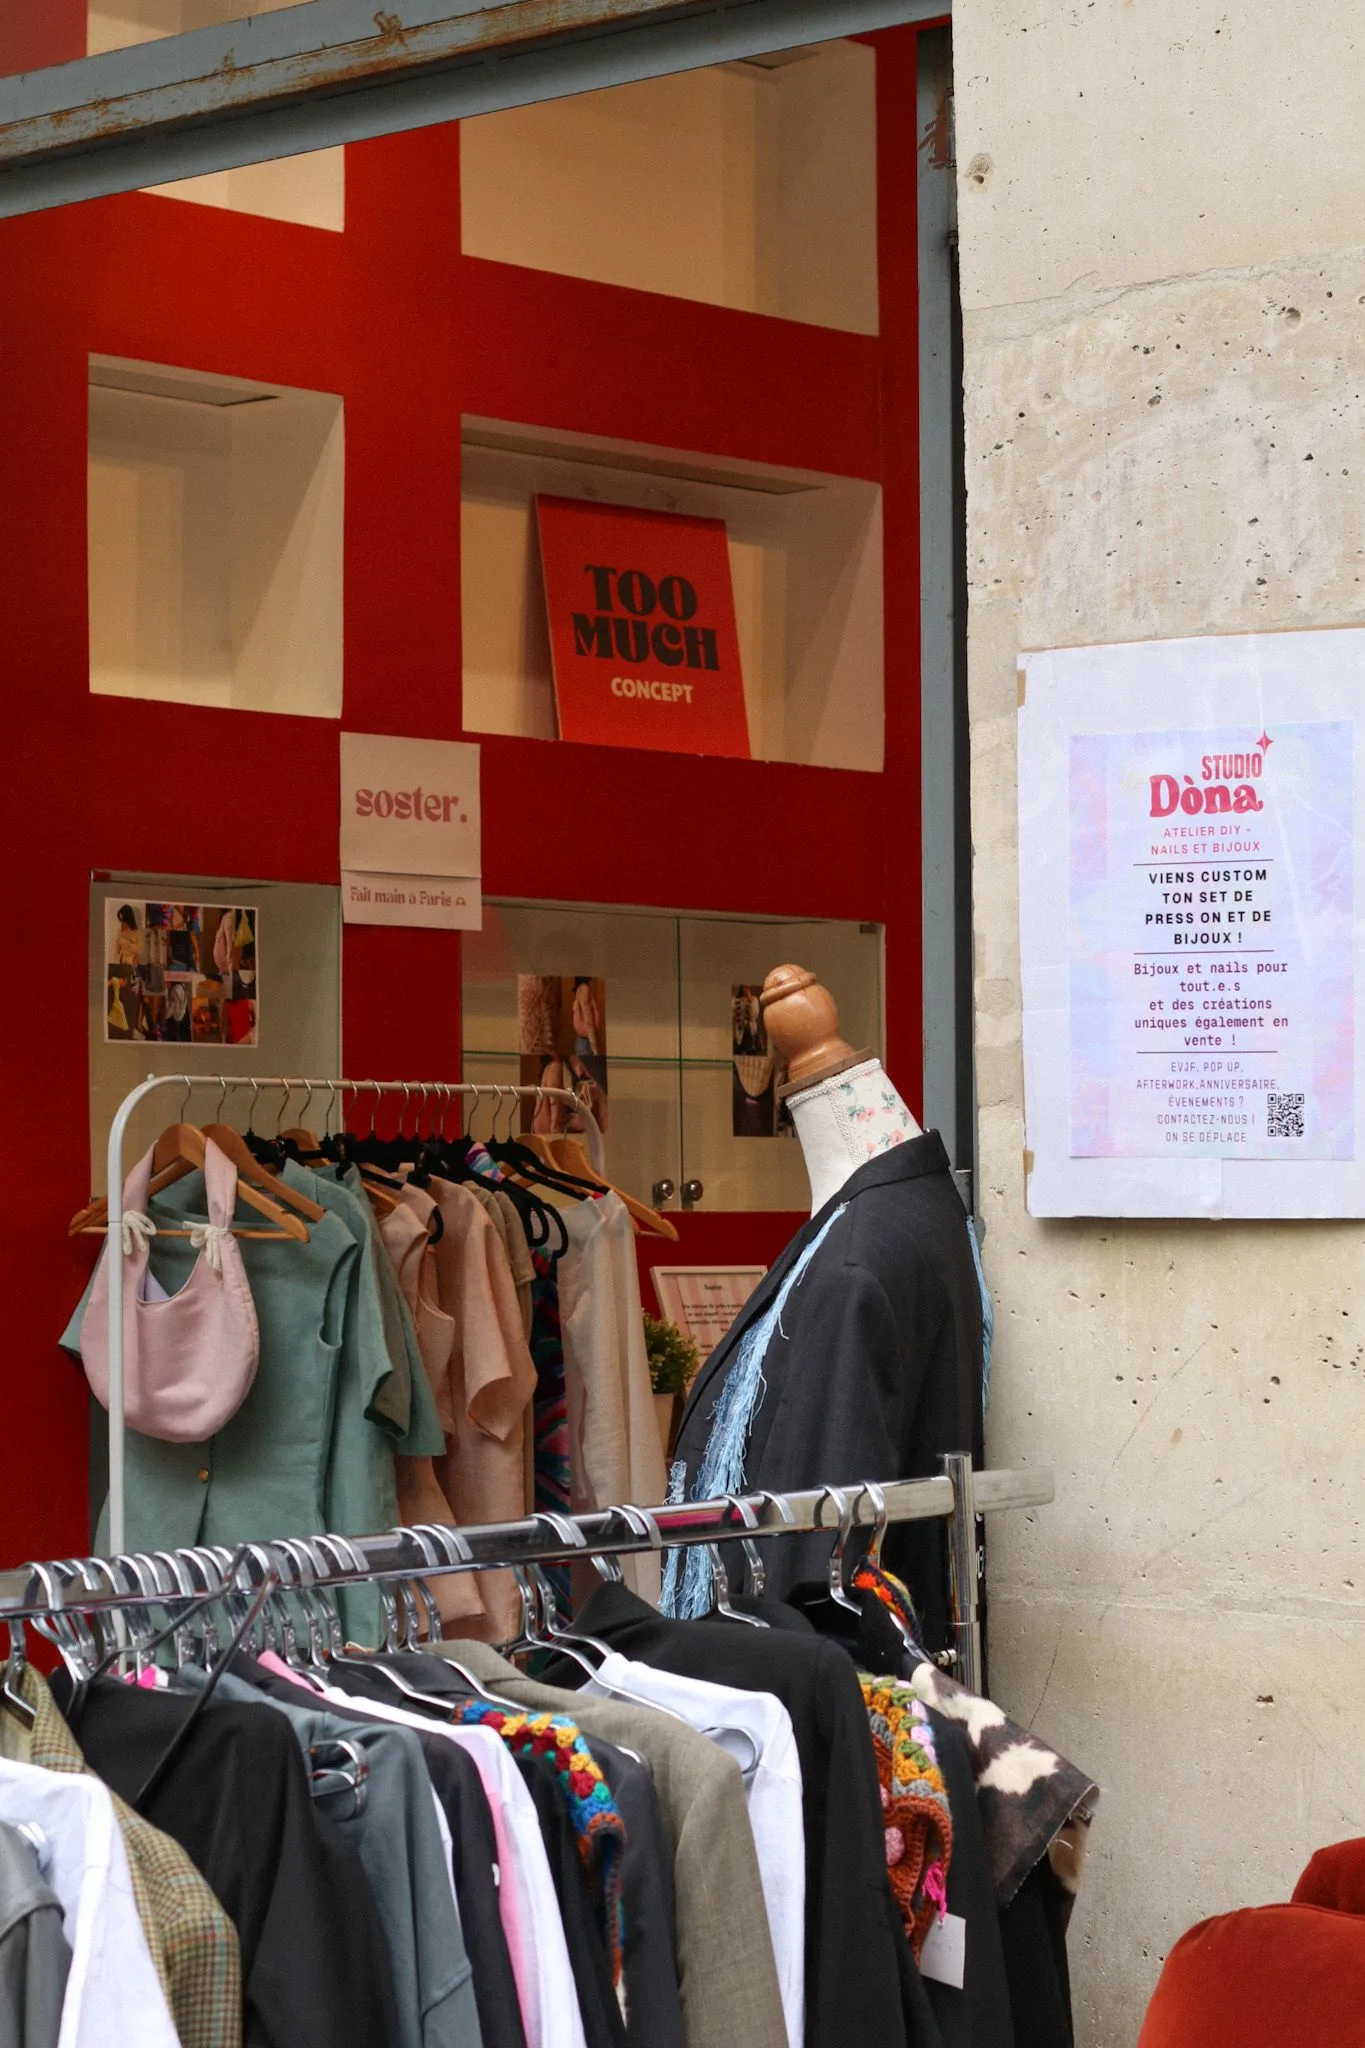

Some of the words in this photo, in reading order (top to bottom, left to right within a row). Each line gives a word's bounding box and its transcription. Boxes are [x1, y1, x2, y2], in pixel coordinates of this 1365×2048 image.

[584, 564, 697, 621] TOO
[571, 613, 719, 671] MUCH
[611, 677, 693, 703] CONCEPT
[1202, 753, 1262, 780] STUDIO
[1149, 774, 1263, 817] Dòna
[355, 785, 467, 823] soster.
[1164, 827, 1215, 837] ATELIER
[1220, 825, 1241, 836] DIY
[1151, 844, 1188, 855] NAILS
[1193, 843, 1208, 854] ET
[1213, 841, 1260, 853] BIJOUX
[1149, 872, 1194, 884] VIENS
[1201, 869, 1267, 883] CUSTOM
[350, 886, 371, 902] Fait
[375, 888, 405, 905] main
[420, 890, 452, 907] Paris
[1163, 892, 1192, 904] TON
[1200, 891, 1226, 903] SET
[1234, 890, 1253, 902] DE
[1145, 912, 1194, 925] PRESS
[1200, 912, 1221, 924] ON
[1228, 911, 1245, 923] ET
[1252, 910, 1272, 922] DE
[1174, 932, 1232, 945] BIJOUX
[1134, 963, 1179, 976] Bijoux
[1187, 963, 1202, 974] et
[1210, 961, 1248, 973] nails
[1257, 962, 1288, 974] pour
[1179, 980, 1241, 992] tout.e.s
[1149, 999, 1164, 1011] et
[1172, 998, 1194, 1010] des
[1202, 997, 1272, 1010] créations
[1134, 1017, 1187, 1030] uniques
[1195, 1016, 1264, 1029] également
[1273, 1017, 1288, 1028] en
[1184, 1035, 1222, 1046] vente
[1203, 1061, 1224, 1072] POP
[1157, 1114, 1248, 1125] CONTACTEZ-NOUS
[1165, 1132, 1179, 1143] ON
[1182, 1131, 1196, 1143] SE
